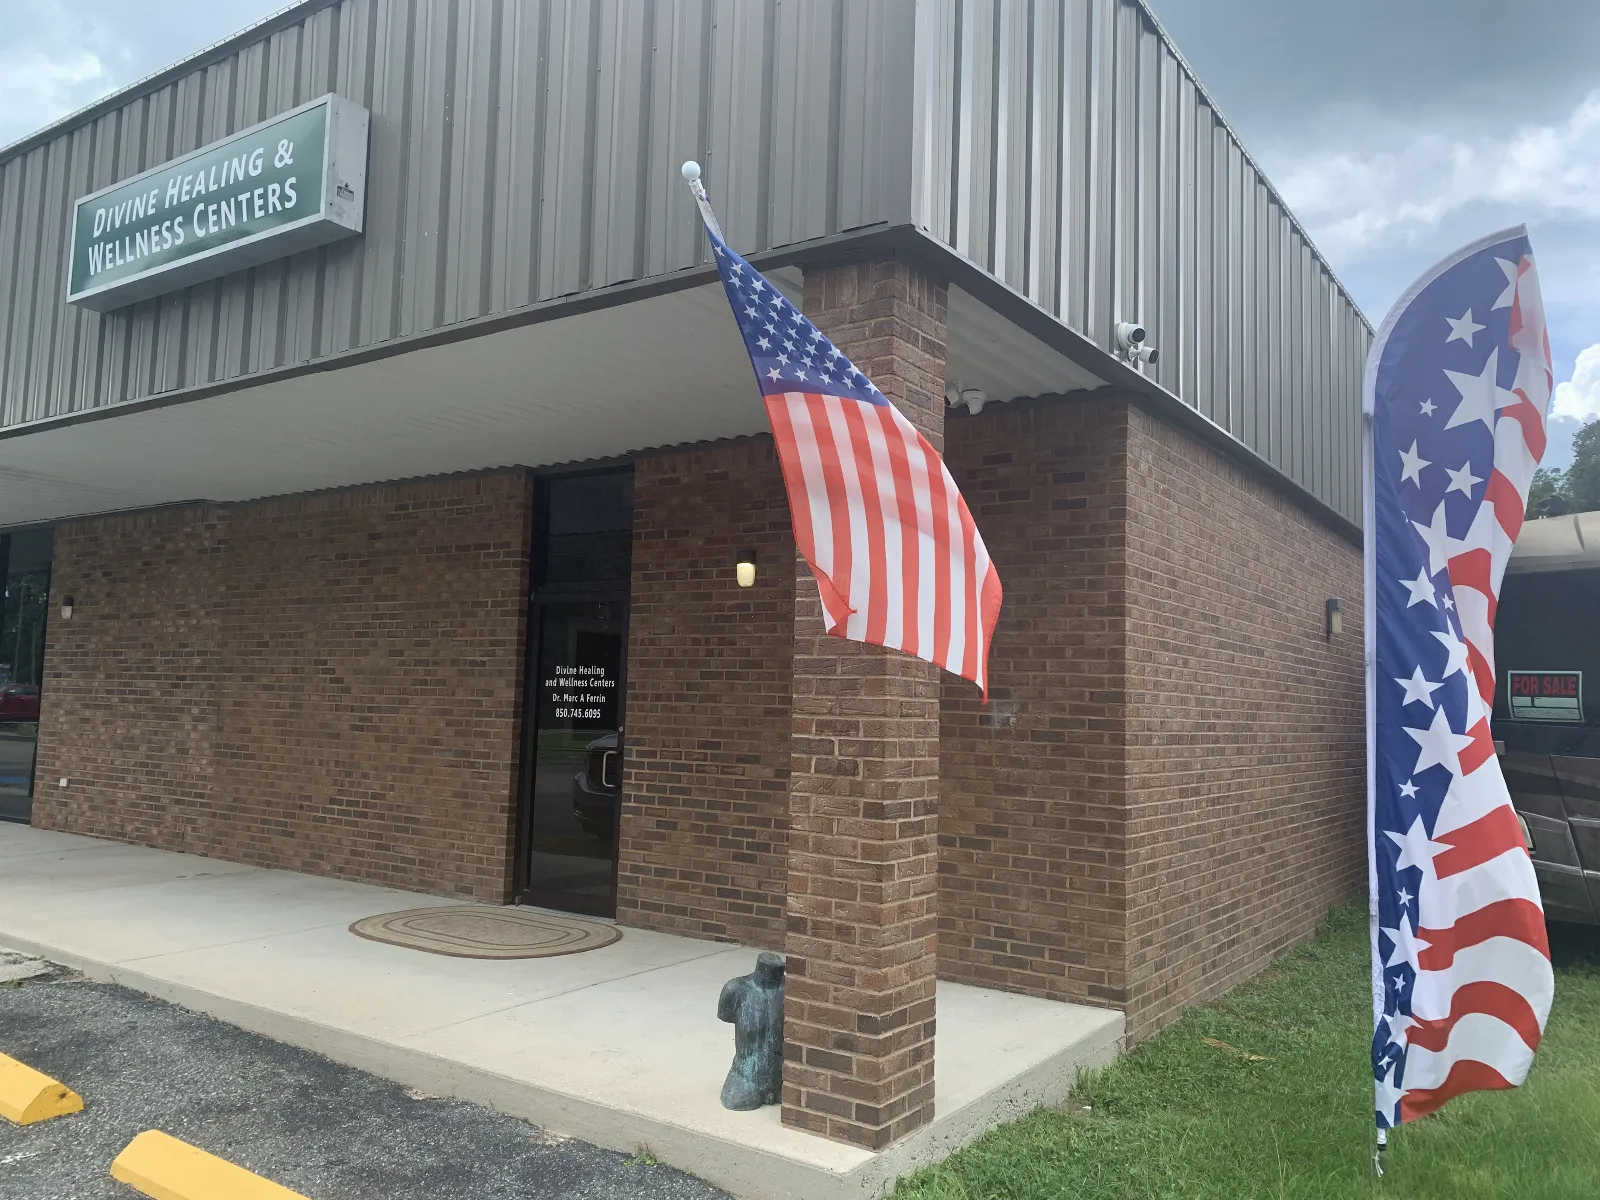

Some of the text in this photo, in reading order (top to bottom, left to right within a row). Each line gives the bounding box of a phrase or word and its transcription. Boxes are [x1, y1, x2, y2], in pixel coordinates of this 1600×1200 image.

[93, 138, 294, 238] DIVINE HEALING &
[88, 177, 297, 275] WELLNESS CENTERS
[556, 666, 604, 677] Divine Healing
[545, 677, 615, 688] and Wellness Centers
[1513, 675, 1577, 696] FOR SALE
[552, 693, 606, 703] Dr. Marc A Ferrin
[555, 708, 601, 719] 850.745.6095
